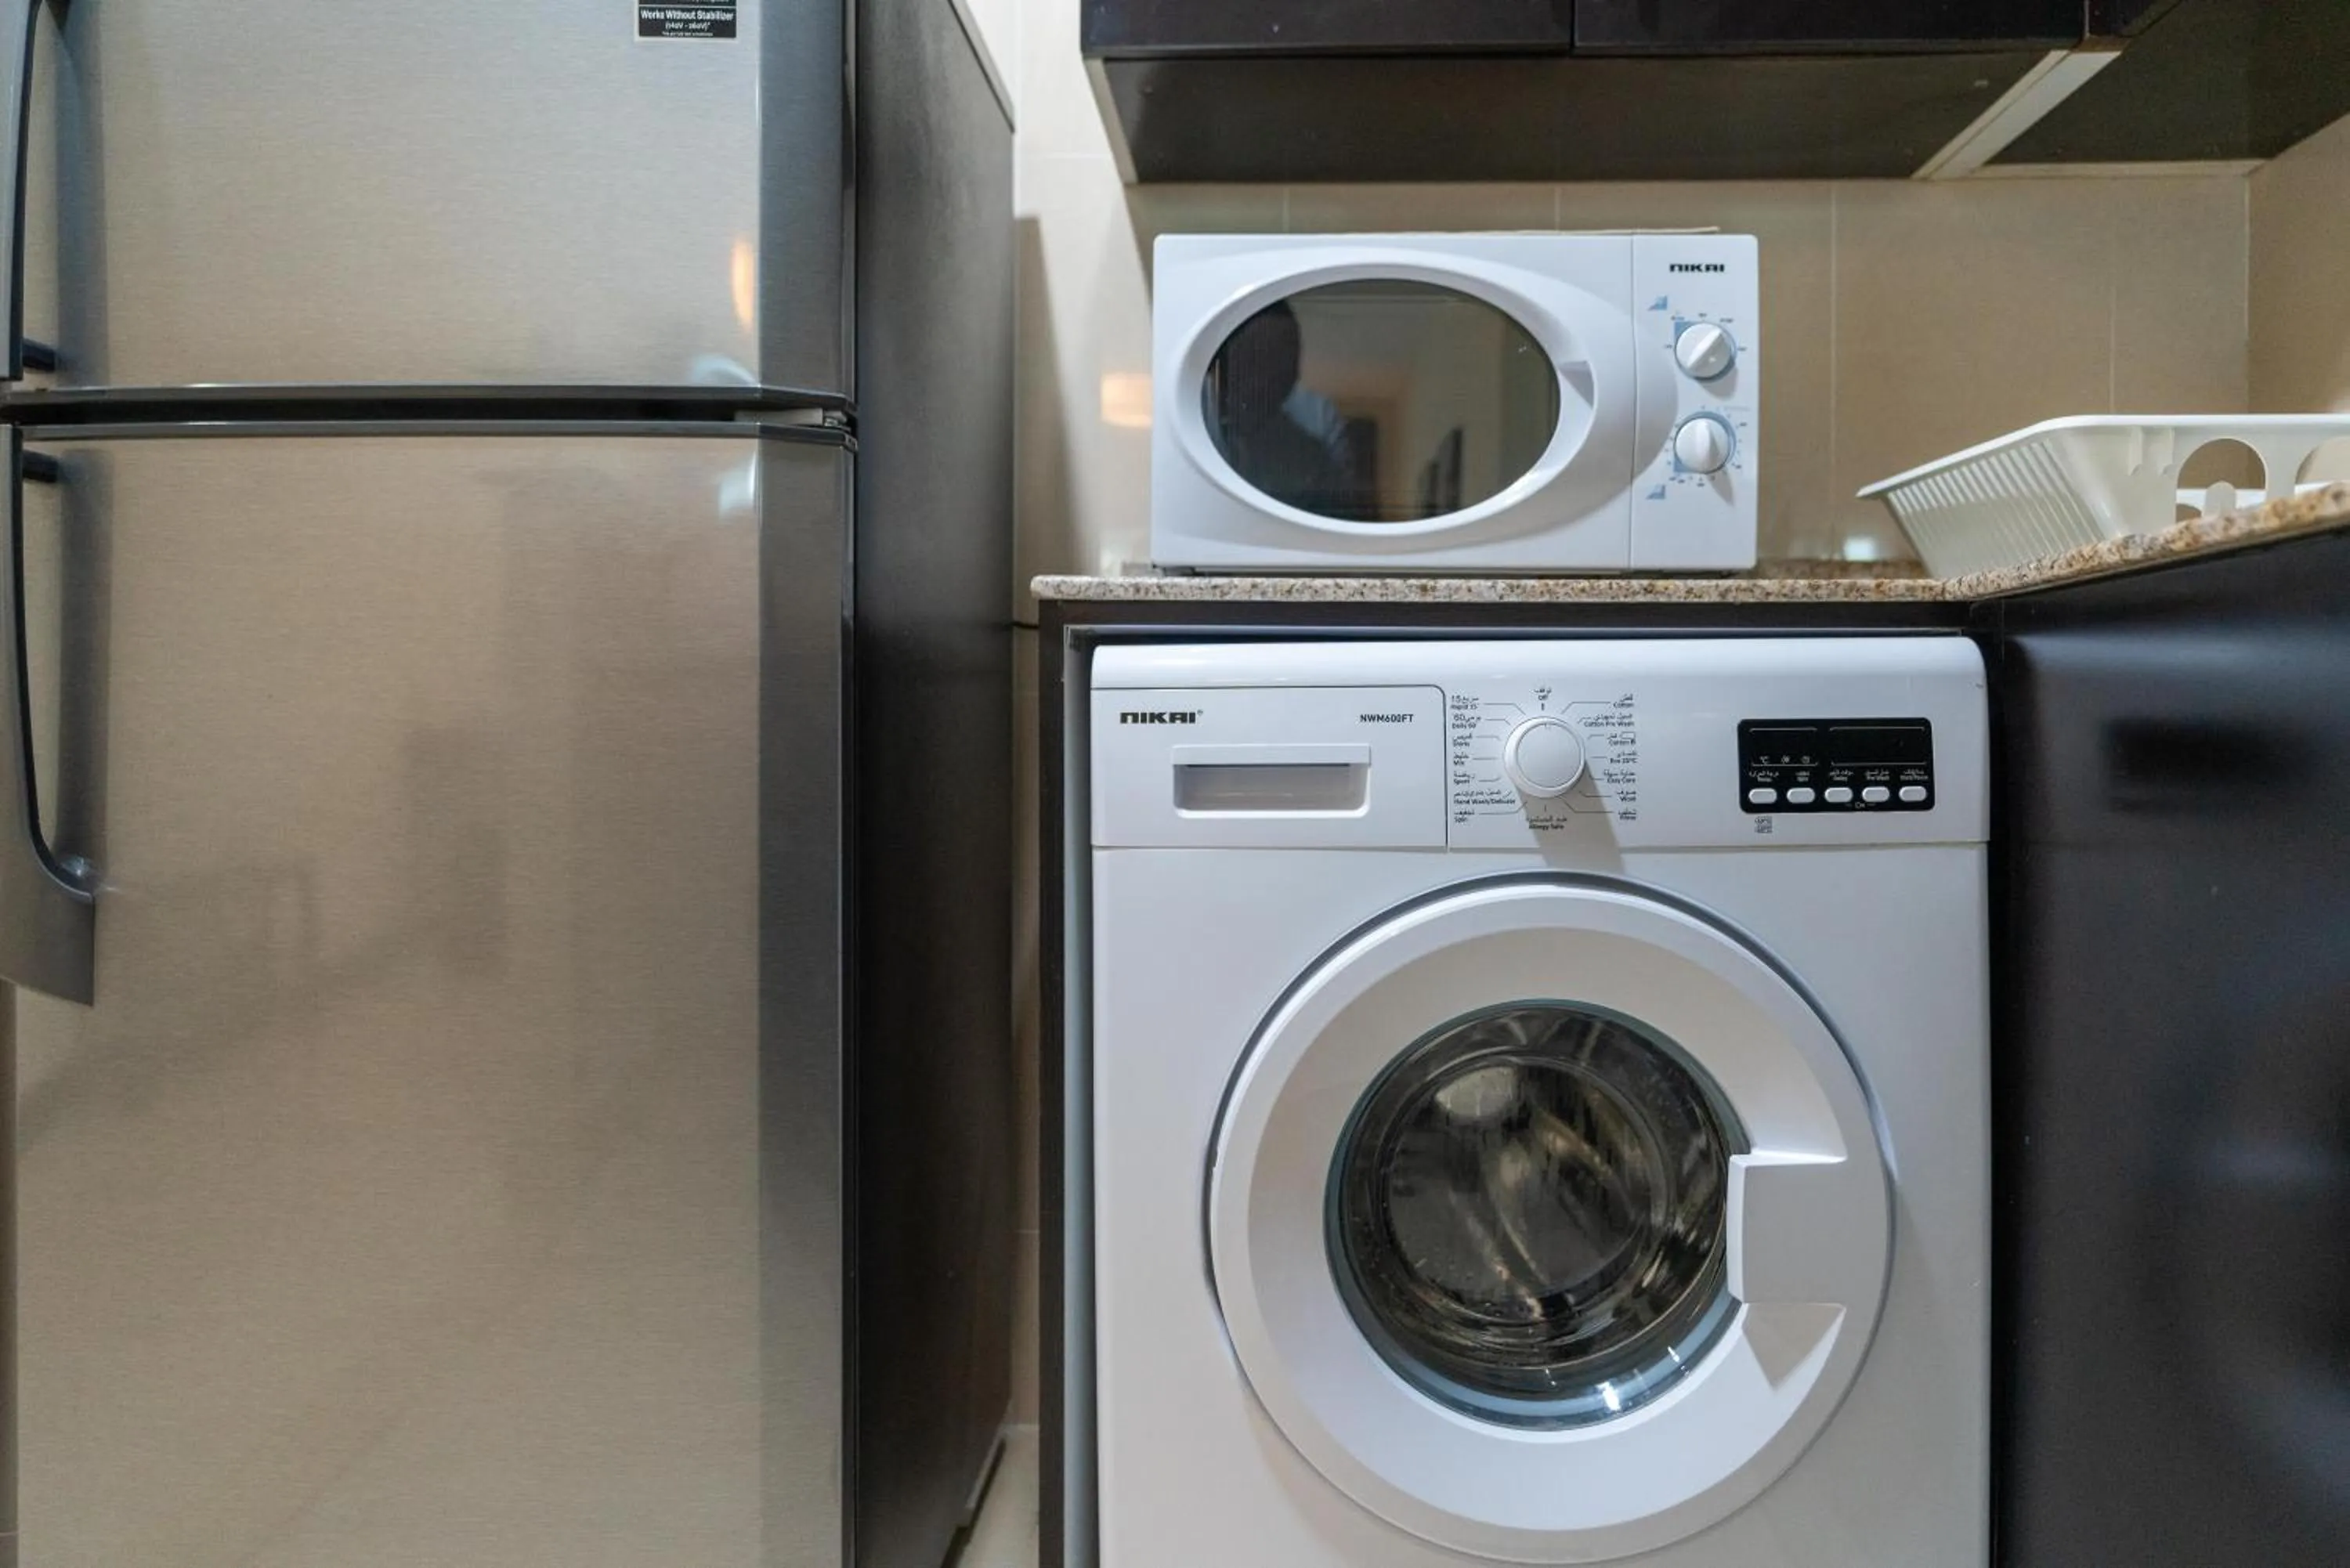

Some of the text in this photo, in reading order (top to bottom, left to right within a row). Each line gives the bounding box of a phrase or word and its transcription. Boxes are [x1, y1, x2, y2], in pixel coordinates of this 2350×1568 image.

[641, 9, 734, 21] Works Without Stabilizer
[1669, 263, 1725, 272] NIKAI
[1120, 712, 1195, 723] NIKAI
